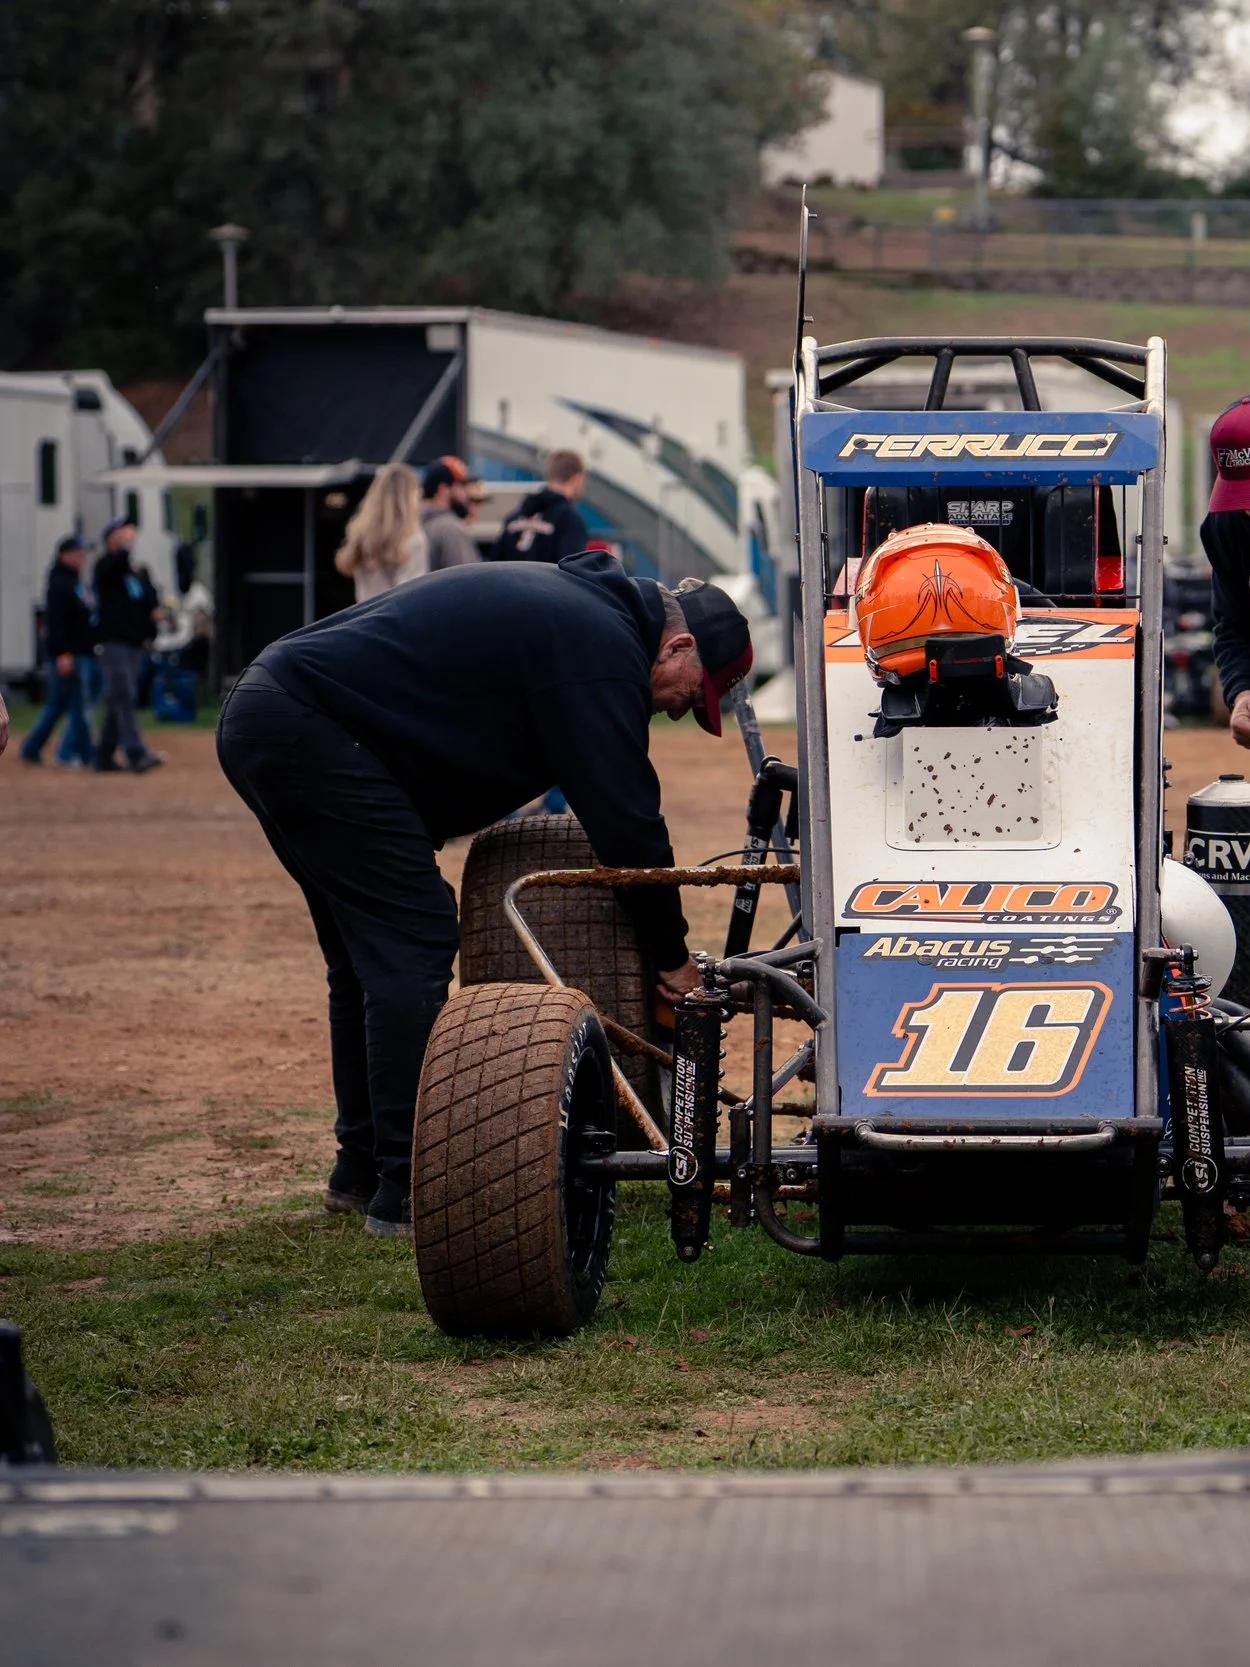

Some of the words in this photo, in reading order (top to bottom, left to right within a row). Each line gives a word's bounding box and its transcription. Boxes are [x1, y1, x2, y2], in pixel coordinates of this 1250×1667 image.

[838, 432, 1119, 458] FERRUCCI
[947, 500, 1015, 513] SHARP
[1211, 872, 1229, 881] and
[850, 883, 1114, 913] CALICO
[986, 914, 1111, 924] COATINGS
[864, 936, 1012, 957] Abacus
[936, 955, 1004, 970] racing
[880, 988, 1096, 1087] 16
[674, 1055, 686, 1143] COMPETITION
[1198, 1083, 1212, 1155] SUSPENSION
